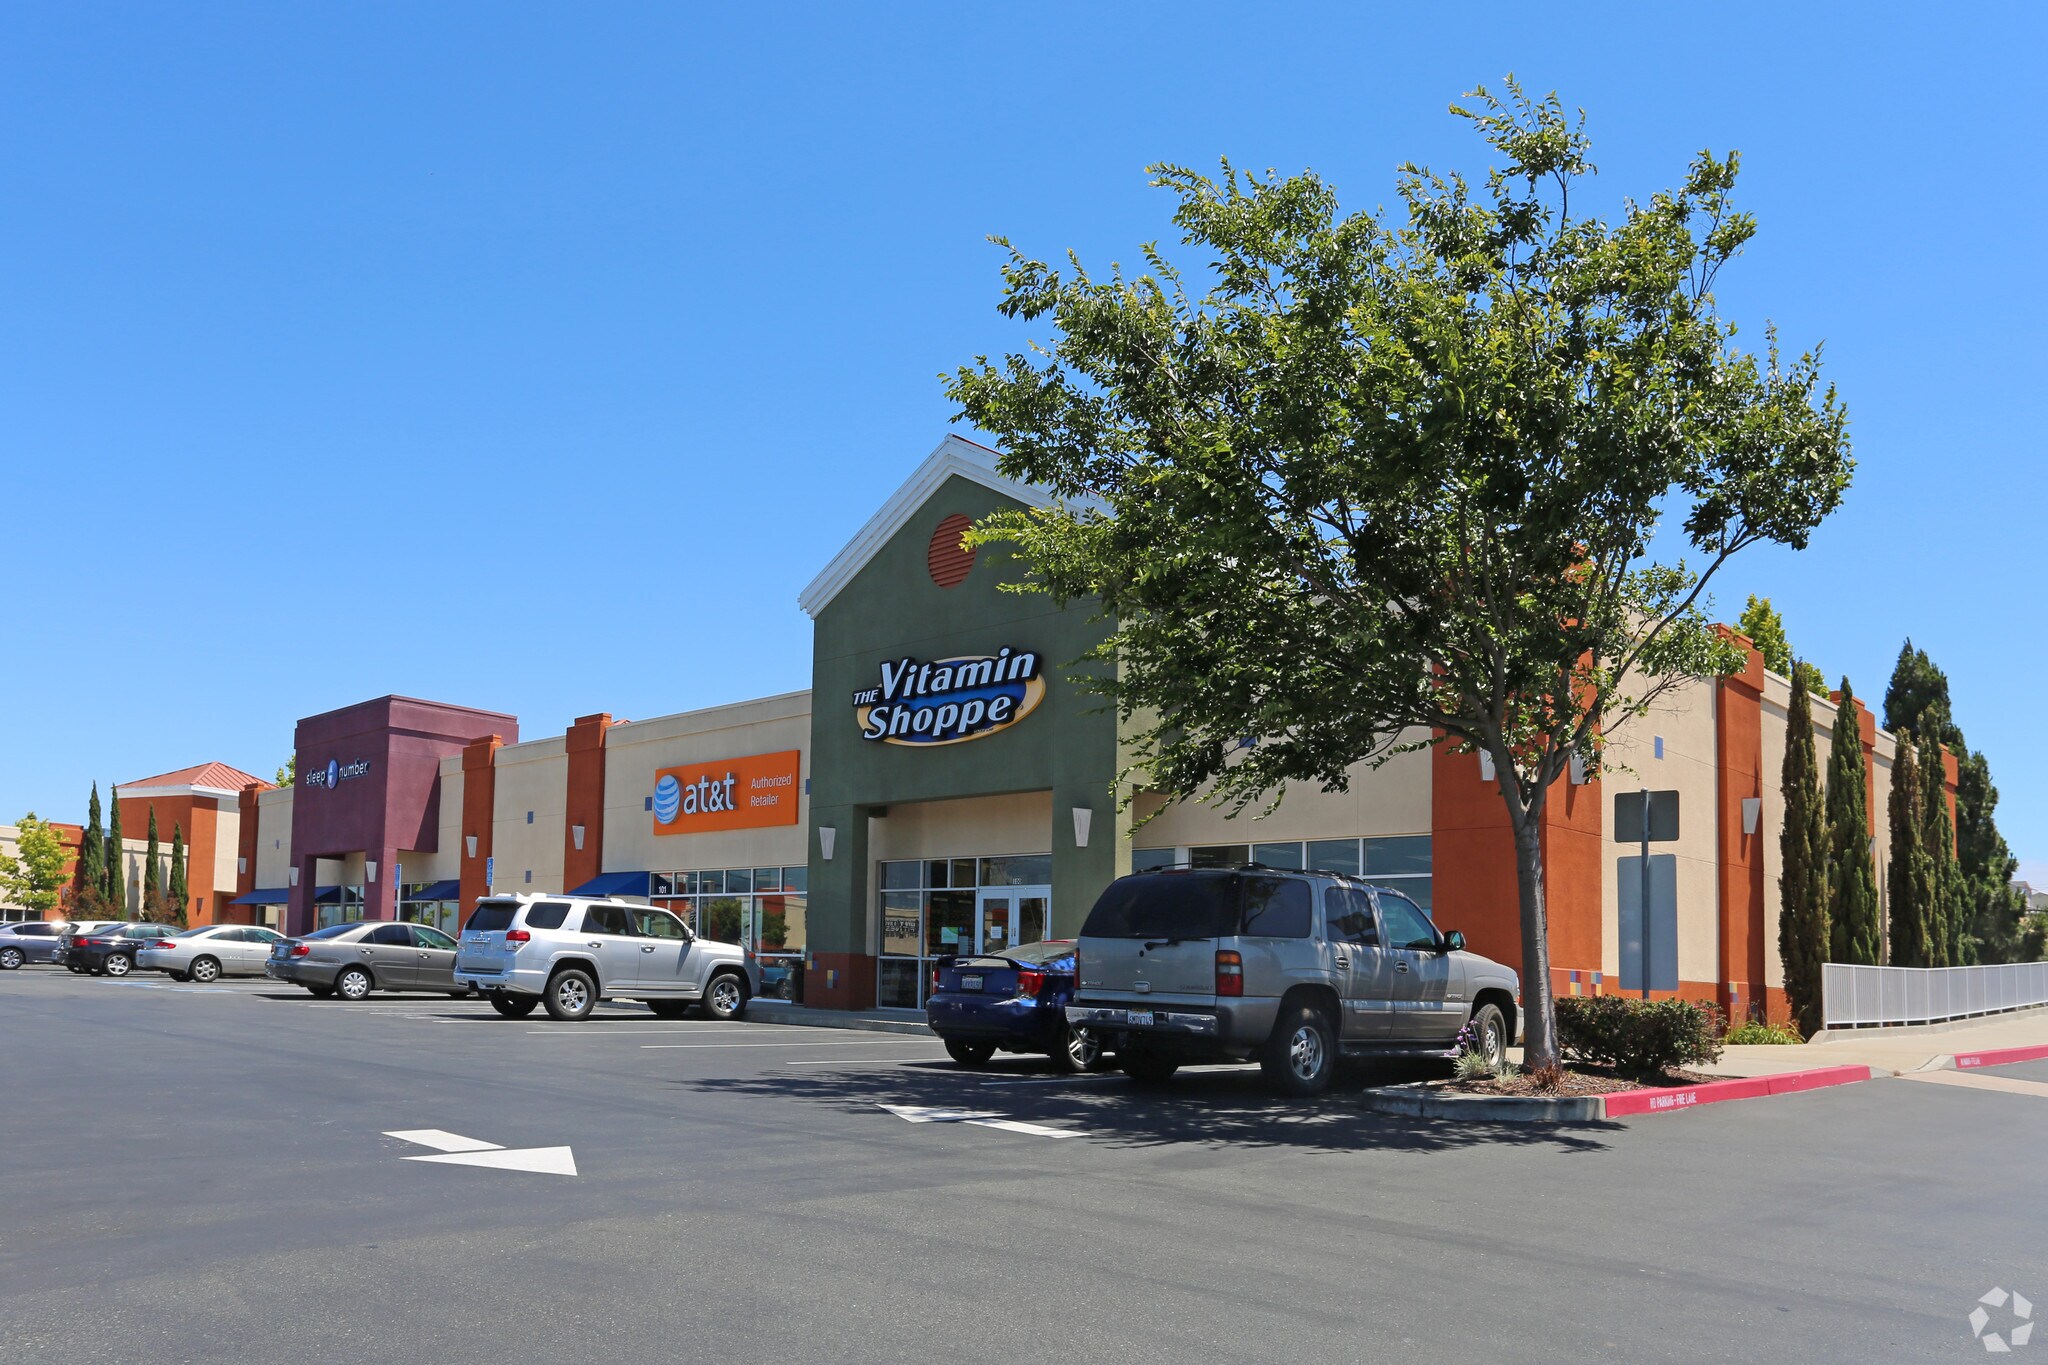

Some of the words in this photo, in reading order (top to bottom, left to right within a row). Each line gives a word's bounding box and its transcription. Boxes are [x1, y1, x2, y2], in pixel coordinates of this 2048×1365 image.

[853, 689, 879, 705] THE
[881, 647, 1036, 700] Vitamin
[863, 696, 1011, 739] Shoppe
[306, 768, 326, 787] sleep
[338, 759, 368, 778] number
[751, 773, 792, 790] Authorized
[683, 772, 735, 815] at&t
[750, 794, 779, 808] Retailer
[658, 885, 667, 894] 101
[1685, 1091, 1697, 1104] LANE
